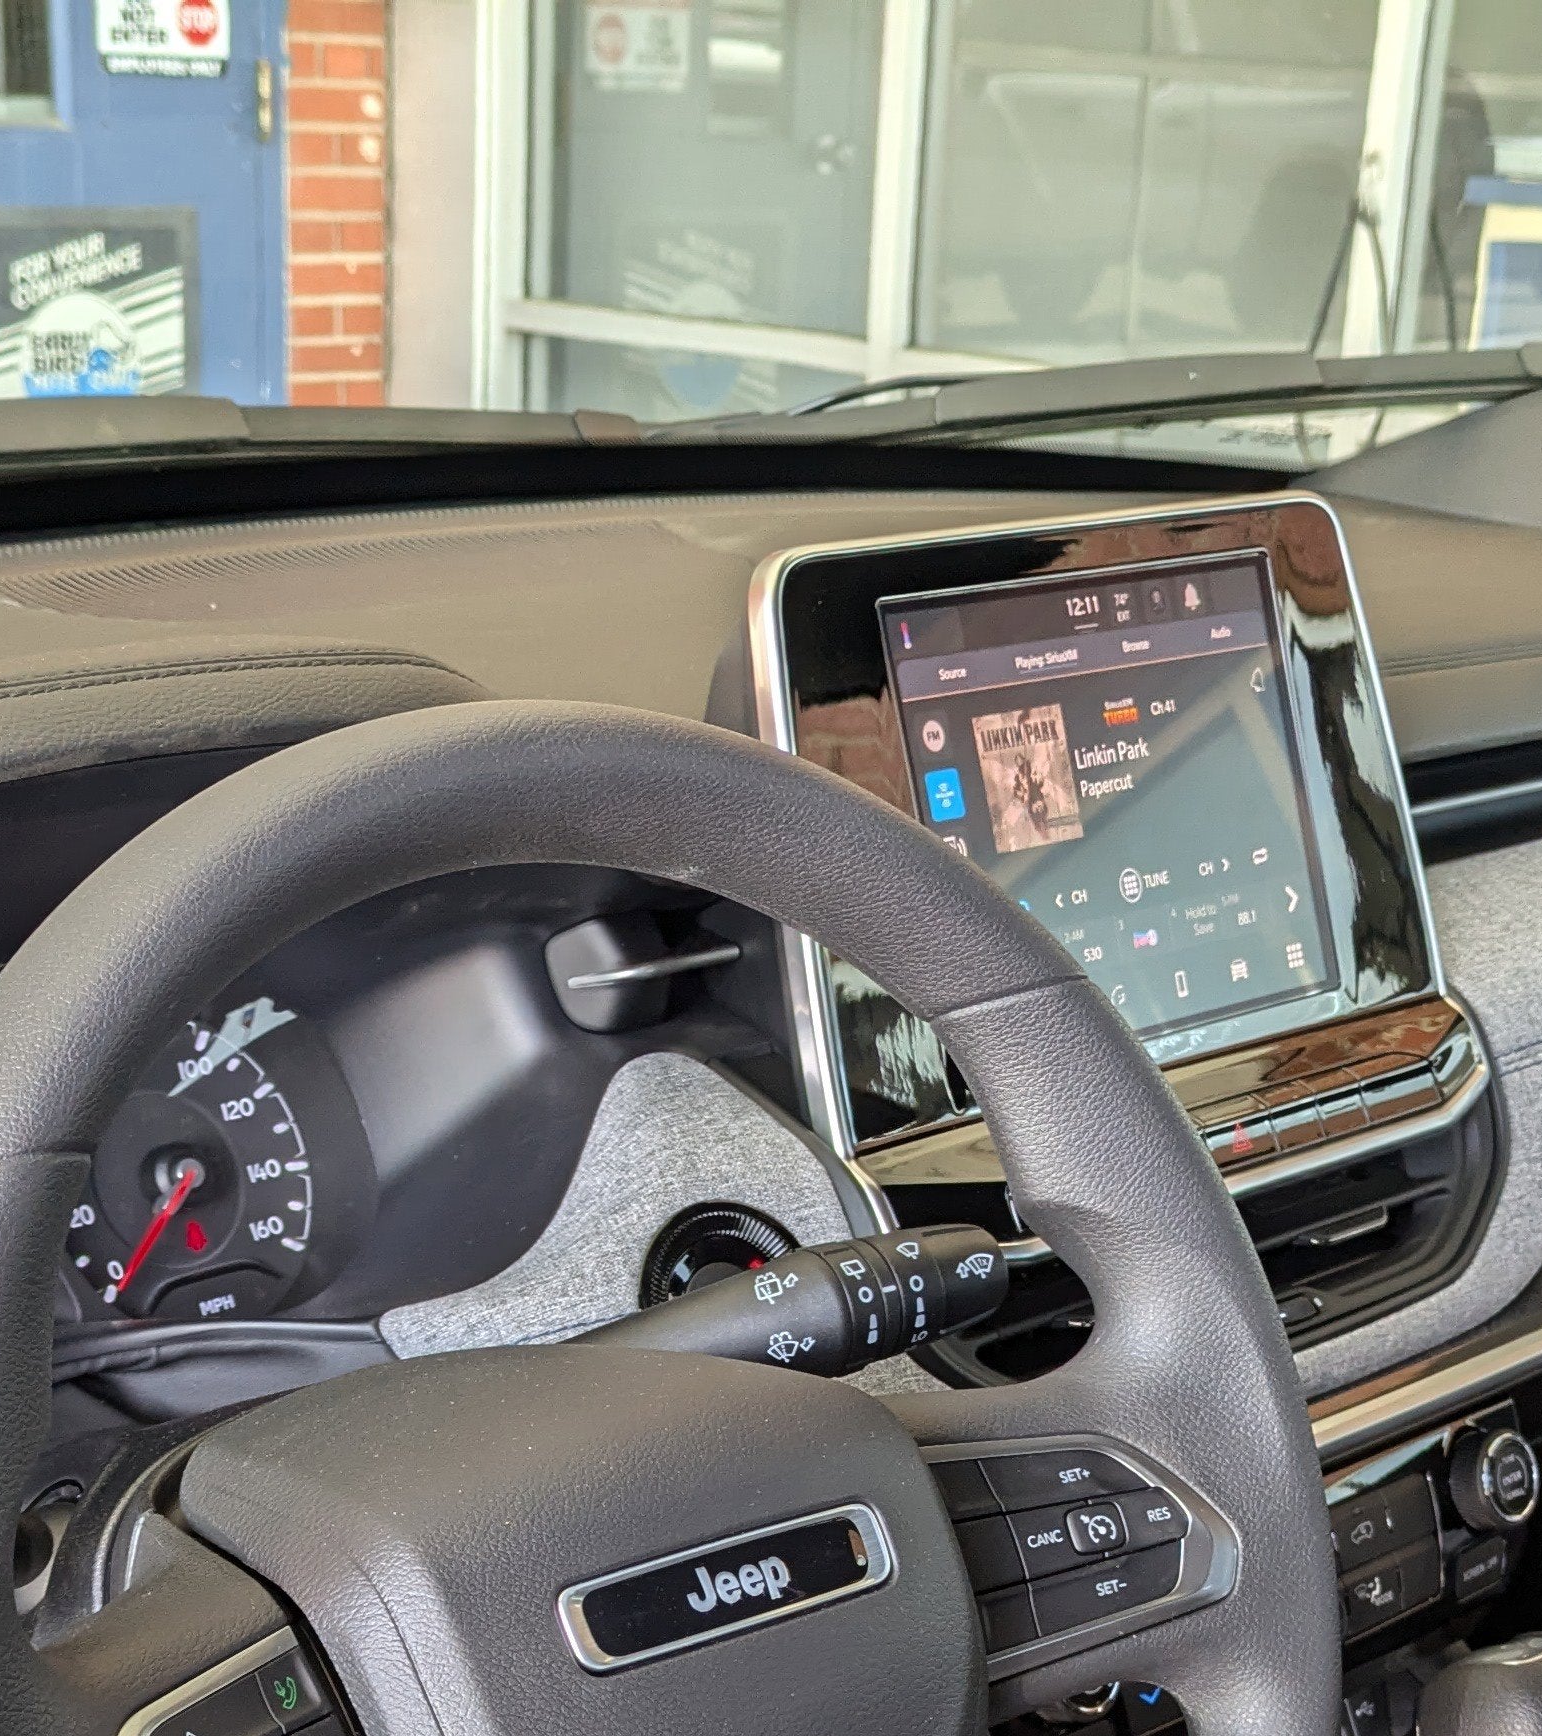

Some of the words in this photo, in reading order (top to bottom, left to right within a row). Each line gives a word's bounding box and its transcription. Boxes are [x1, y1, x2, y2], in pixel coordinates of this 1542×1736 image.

[938, 668, 968, 681] Source
[926, 730, 941, 742] FM
[980, 724, 1025, 752] LINKIN
[1023, 719, 1060, 746] PARK
[1074, 743, 1117, 770] Linkin
[1116, 737, 1150, 762] Park
[1079, 774, 1135, 800] Papercut
[1143, 870, 1170, 888] TUNE
[1198, 861, 1214, 876] CH
[1071, 888, 1088, 905] CH
[177, 1057, 214, 1082] 100
[219, 1097, 255, 1122] 120
[246, 1159, 282, 1184] 140
[249, 1215, 285, 1242] 160
[198, 1293, 236, 1317] MPH
[1146, 1506, 1172, 1523] RES
[1027, 1529, 1064, 1549] CANC
[686, 1556, 792, 1613] Jeep
